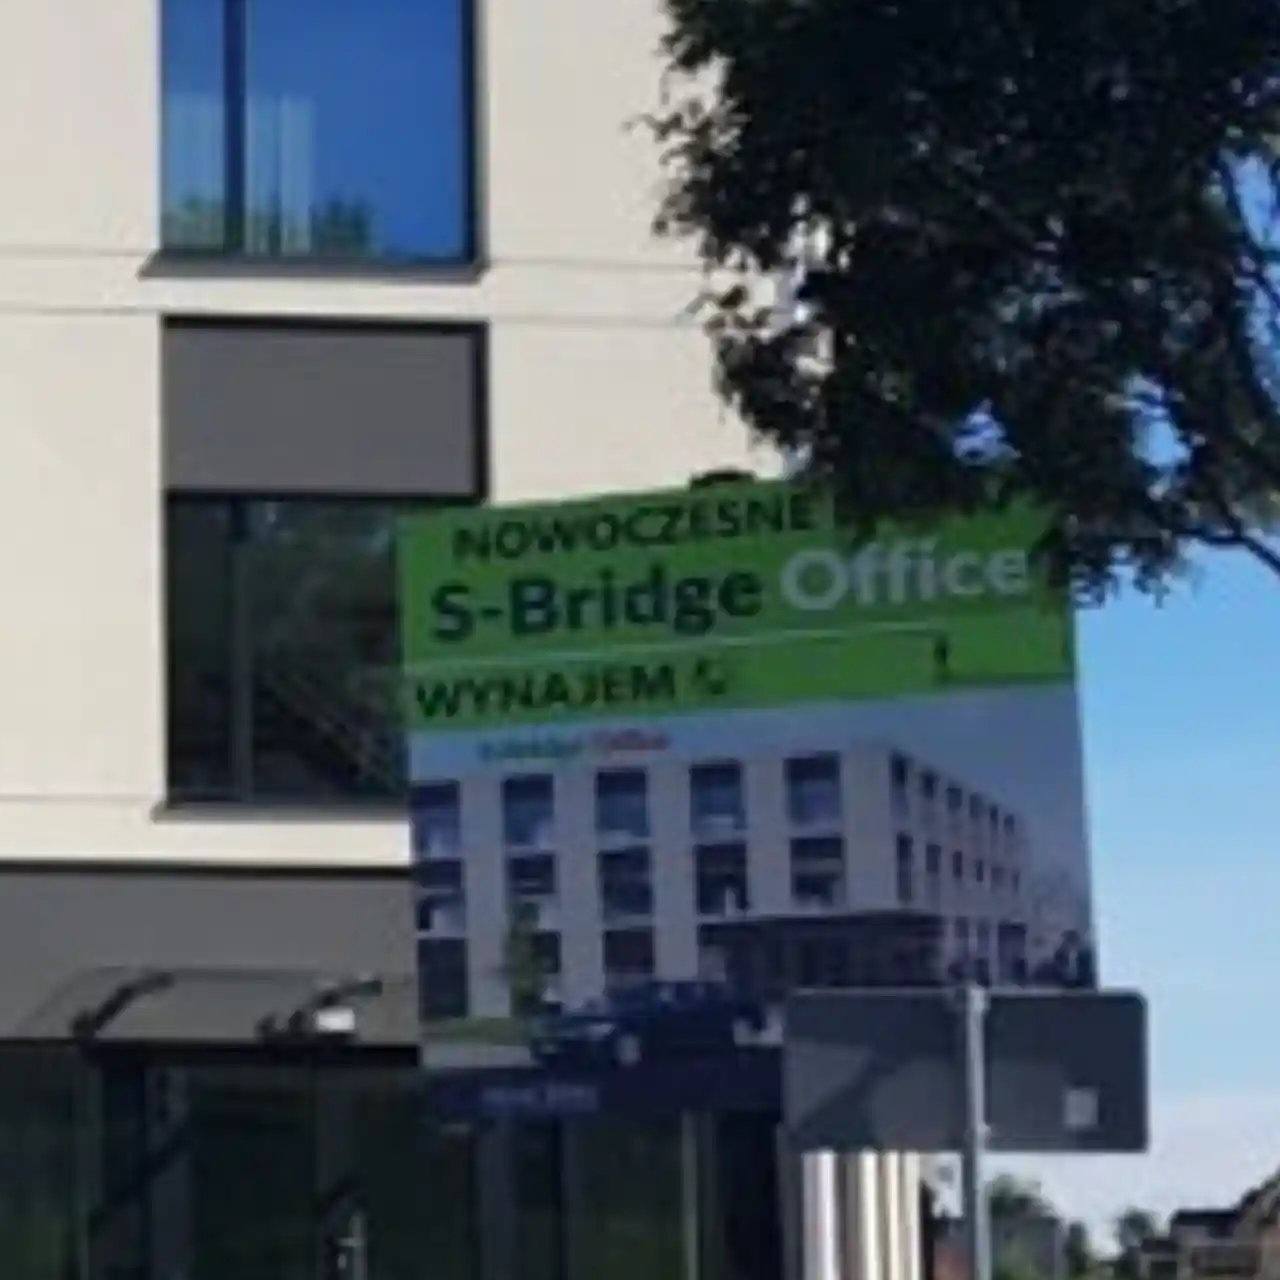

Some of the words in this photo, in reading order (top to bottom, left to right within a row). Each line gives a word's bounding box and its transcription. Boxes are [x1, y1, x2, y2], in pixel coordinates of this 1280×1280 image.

[453, 493, 816, 563] NOWOCZESNE
[430, 562, 764, 639] S-Bridge
[781, 538, 1031, 610] Office
[415, 664, 676, 719] WYNAJEM
